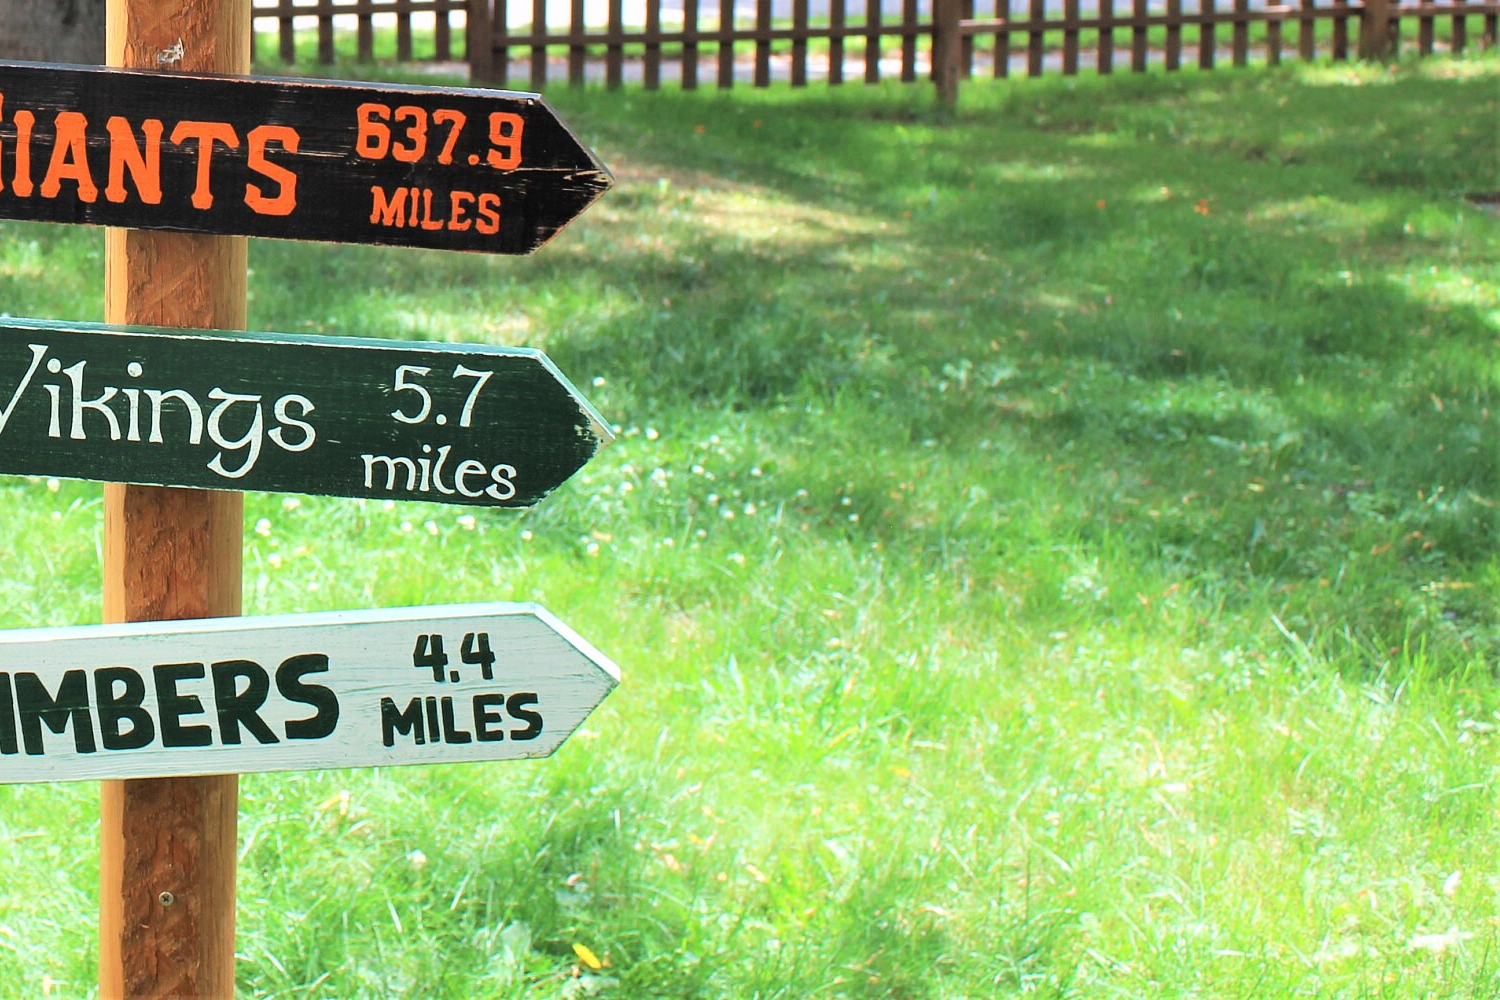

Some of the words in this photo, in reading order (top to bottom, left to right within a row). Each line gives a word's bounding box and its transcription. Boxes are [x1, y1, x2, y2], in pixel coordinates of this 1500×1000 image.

[355, 103, 525, 169] 637.9
[370, 186, 501, 235] MILES
[392, 365, 494, 429] 5.7
[361, 444, 517, 501] miles
[413, 633, 496, 684] 4.4
[381, 691, 543, 748] MILES
